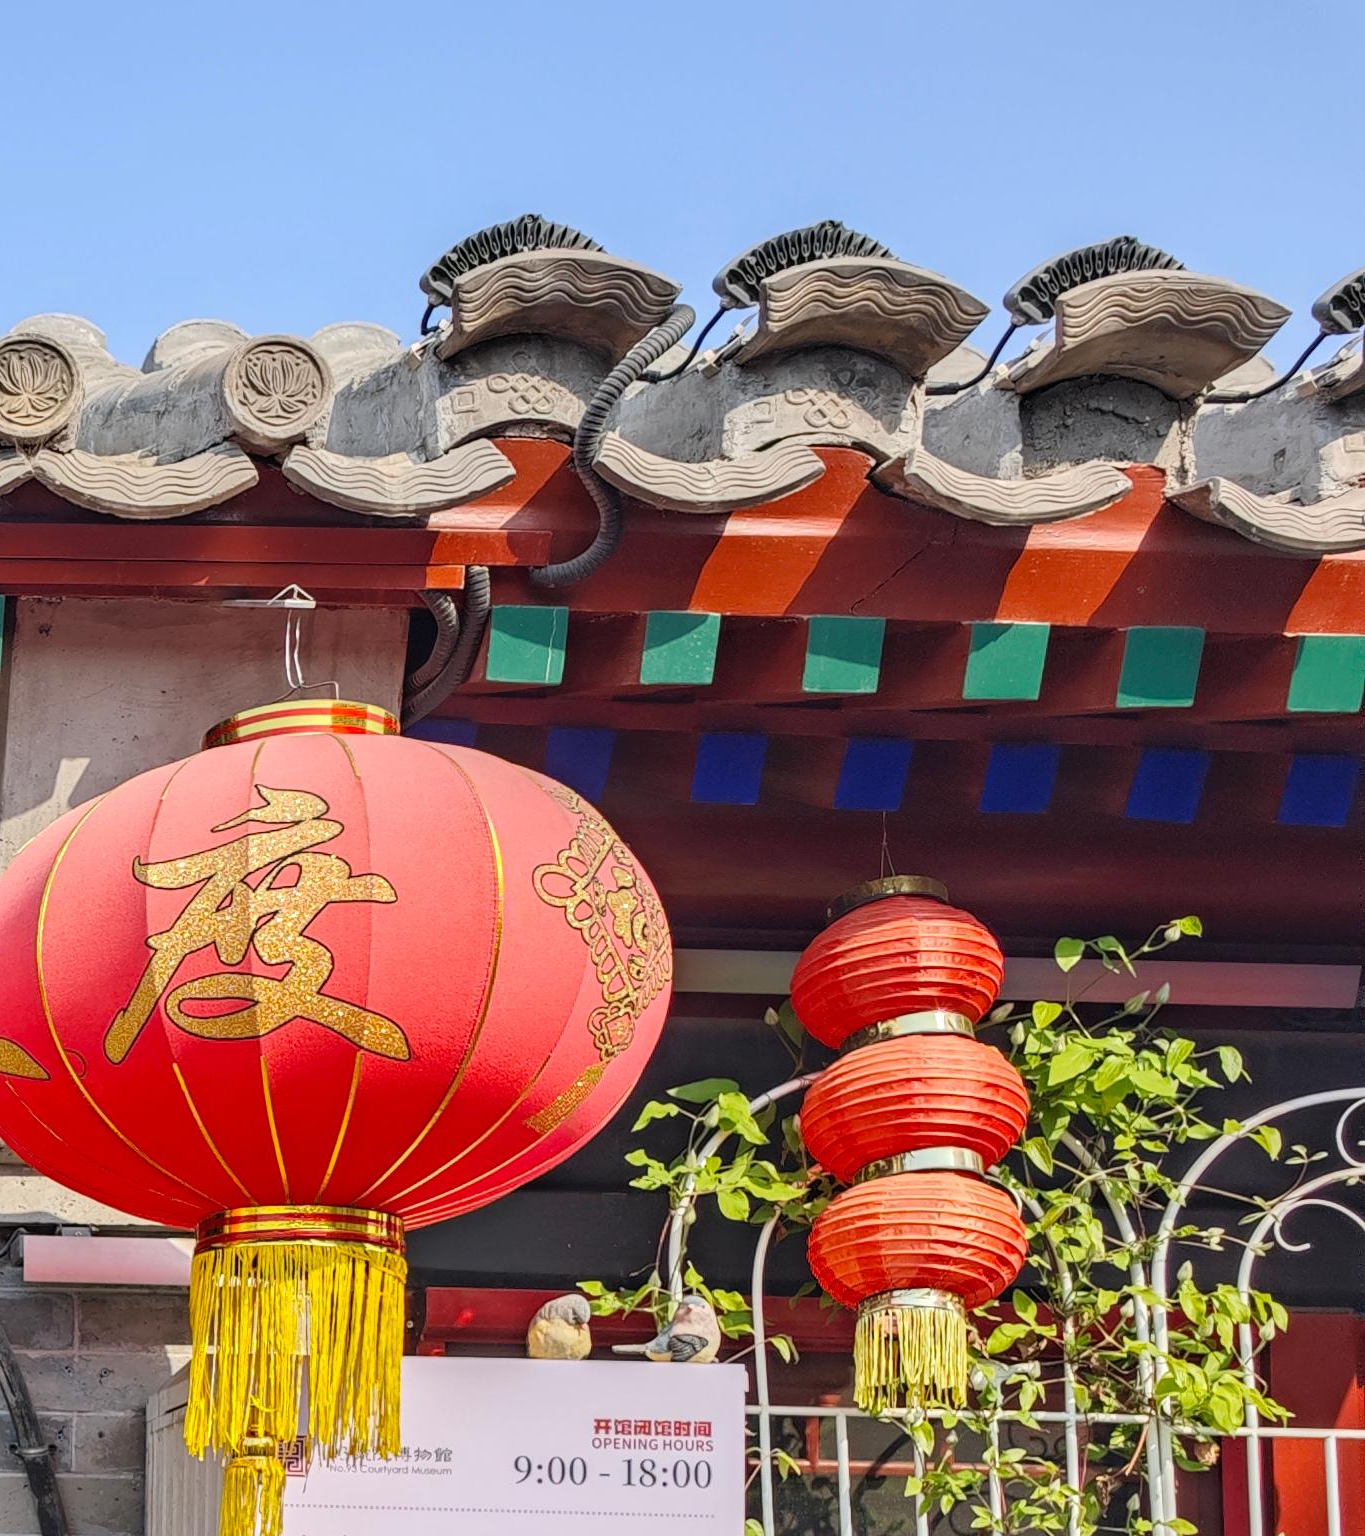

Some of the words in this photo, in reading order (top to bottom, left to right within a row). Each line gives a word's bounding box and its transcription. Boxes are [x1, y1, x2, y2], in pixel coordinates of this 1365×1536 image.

[593, 1418, 713, 1438] 开馆闭馆时间
[592, 1438, 657, 1451] OPENING
[661, 1440, 714, 1453] HOURS
[360, 1465, 408, 1475] Courtyard
[412, 1466, 452, 1475] Museum
[514, 1456, 588, 1486] 9:00
[621, 1460, 713, 1489] 18:00
